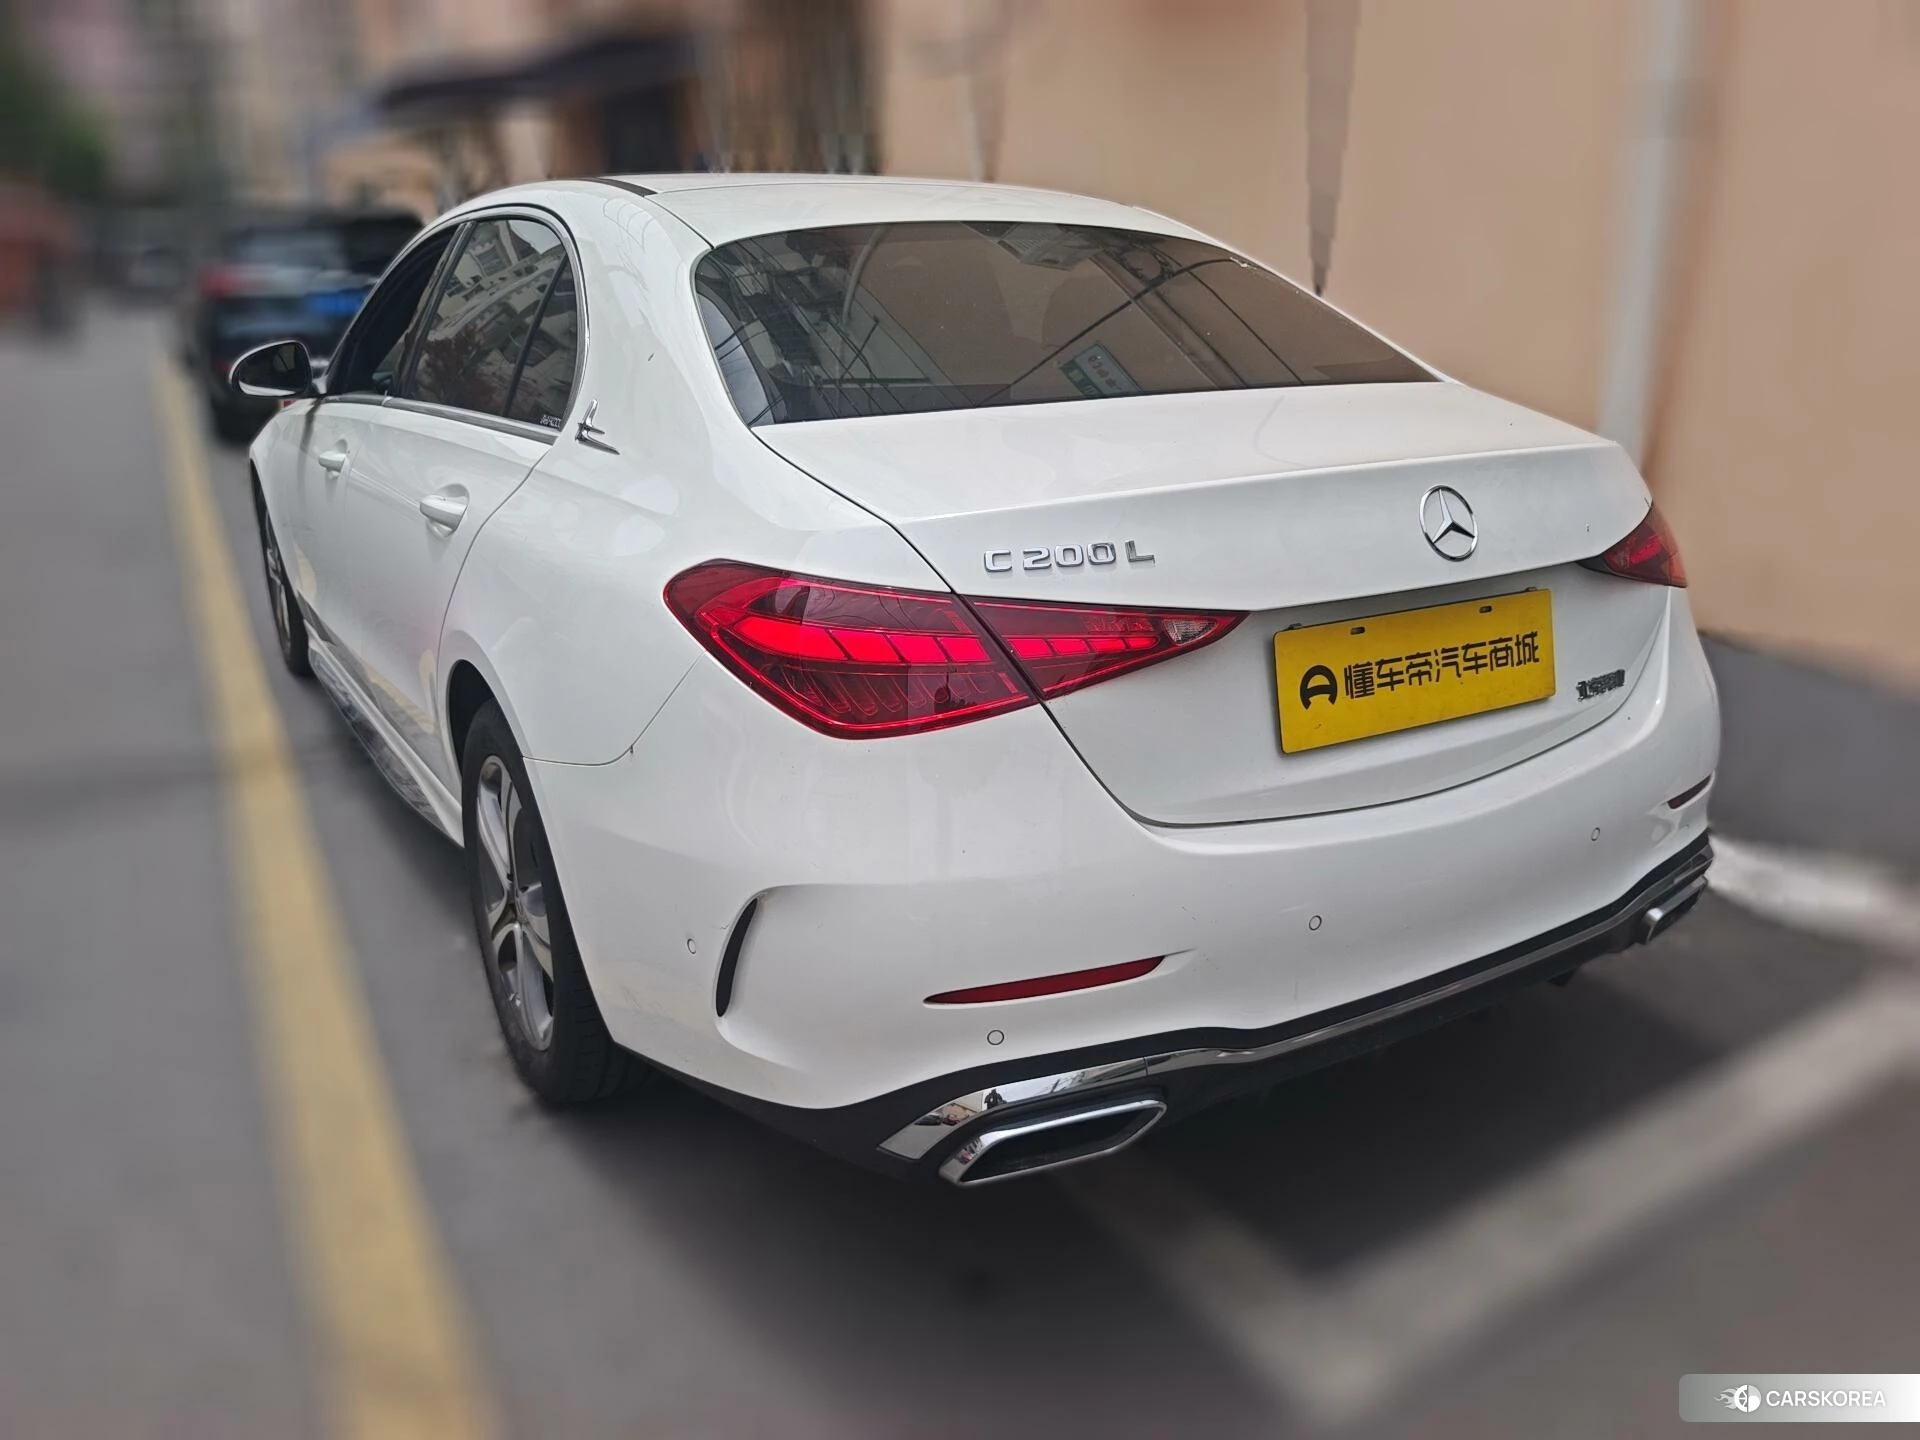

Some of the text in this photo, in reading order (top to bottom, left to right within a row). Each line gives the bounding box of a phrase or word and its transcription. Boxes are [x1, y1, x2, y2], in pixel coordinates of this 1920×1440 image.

[984, 539, 1156, 572] C 200 L
[1343, 630, 1540, 700] 懂车帝汽车商城
